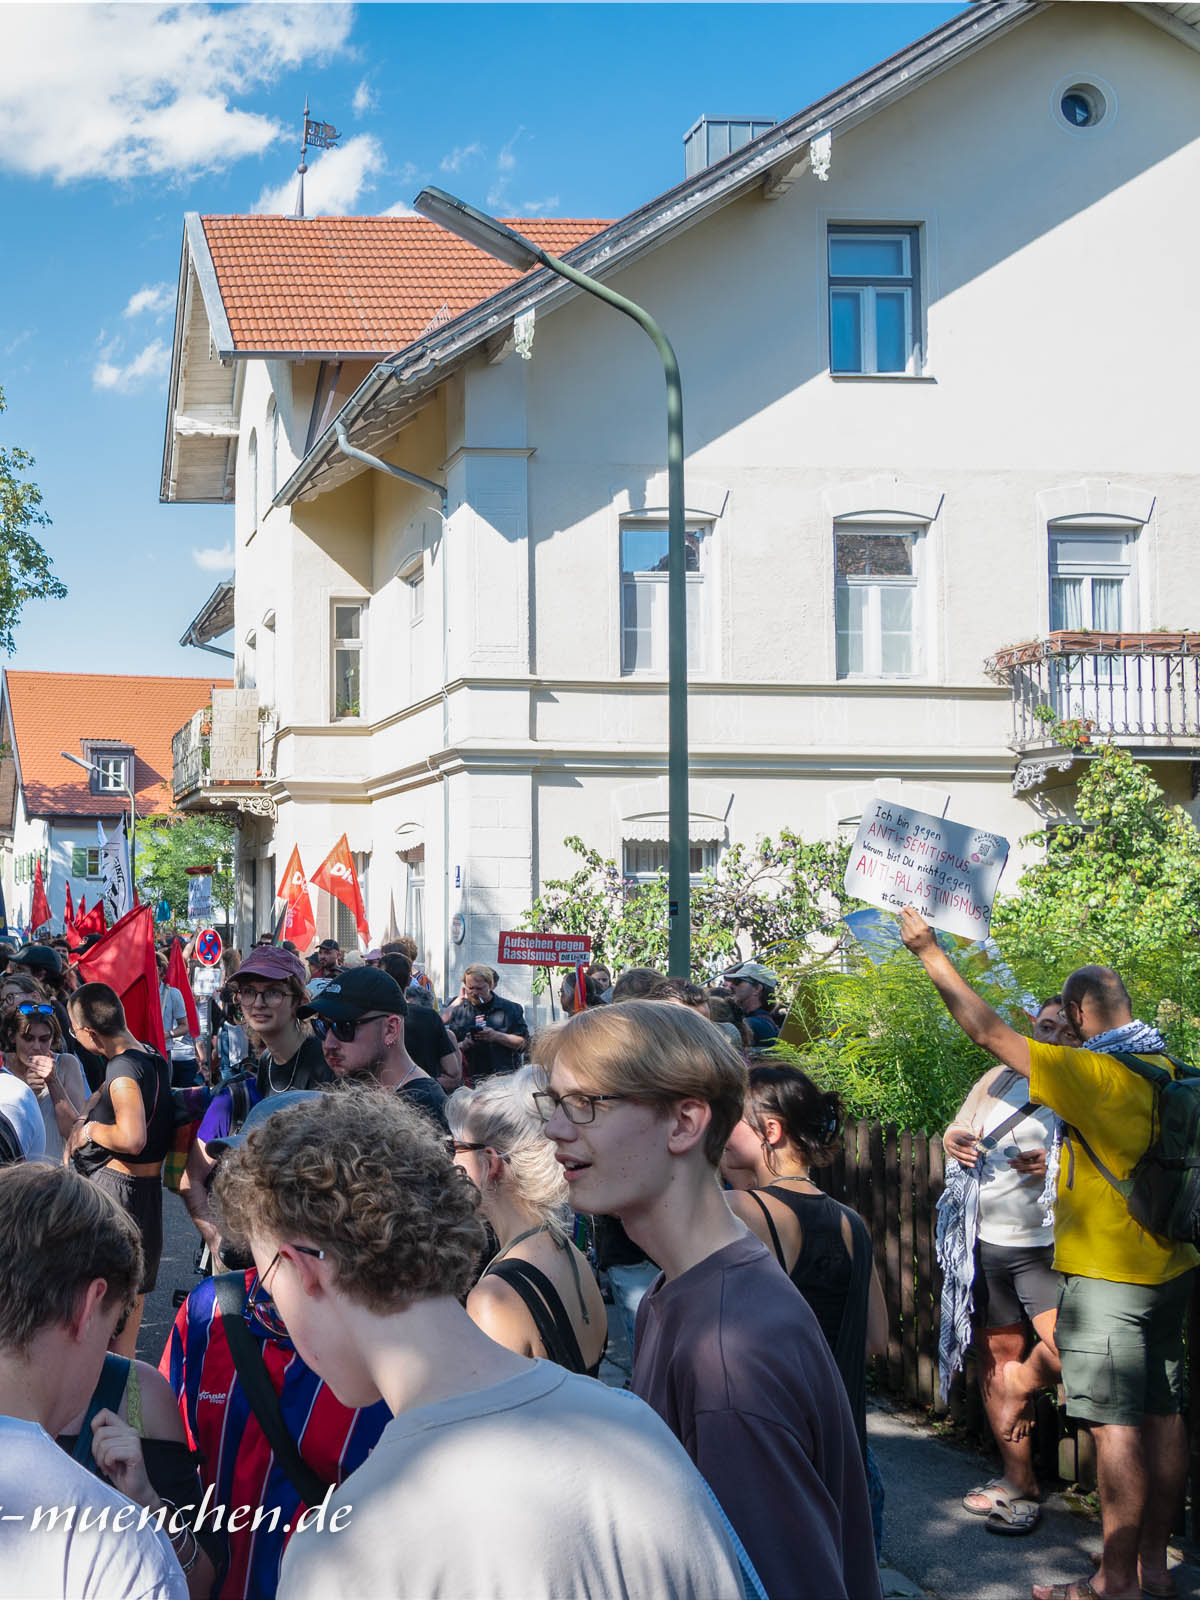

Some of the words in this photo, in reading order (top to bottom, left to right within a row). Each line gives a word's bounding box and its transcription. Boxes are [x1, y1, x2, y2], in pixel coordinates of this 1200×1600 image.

[875, 806, 892, 822] Ich
[896, 814, 910, 829] bin
[912, 824, 942, 841] gegen
[862, 840, 884, 858] Warum
[886, 848, 901, 864] bist
[917, 864, 939, 876] nicht
[939, 871, 972, 893] gegen
[503, 948, 556, 962] Rassismus
[504, 936, 553, 949] Aufstehen
[554, 941, 585, 952] gegen
